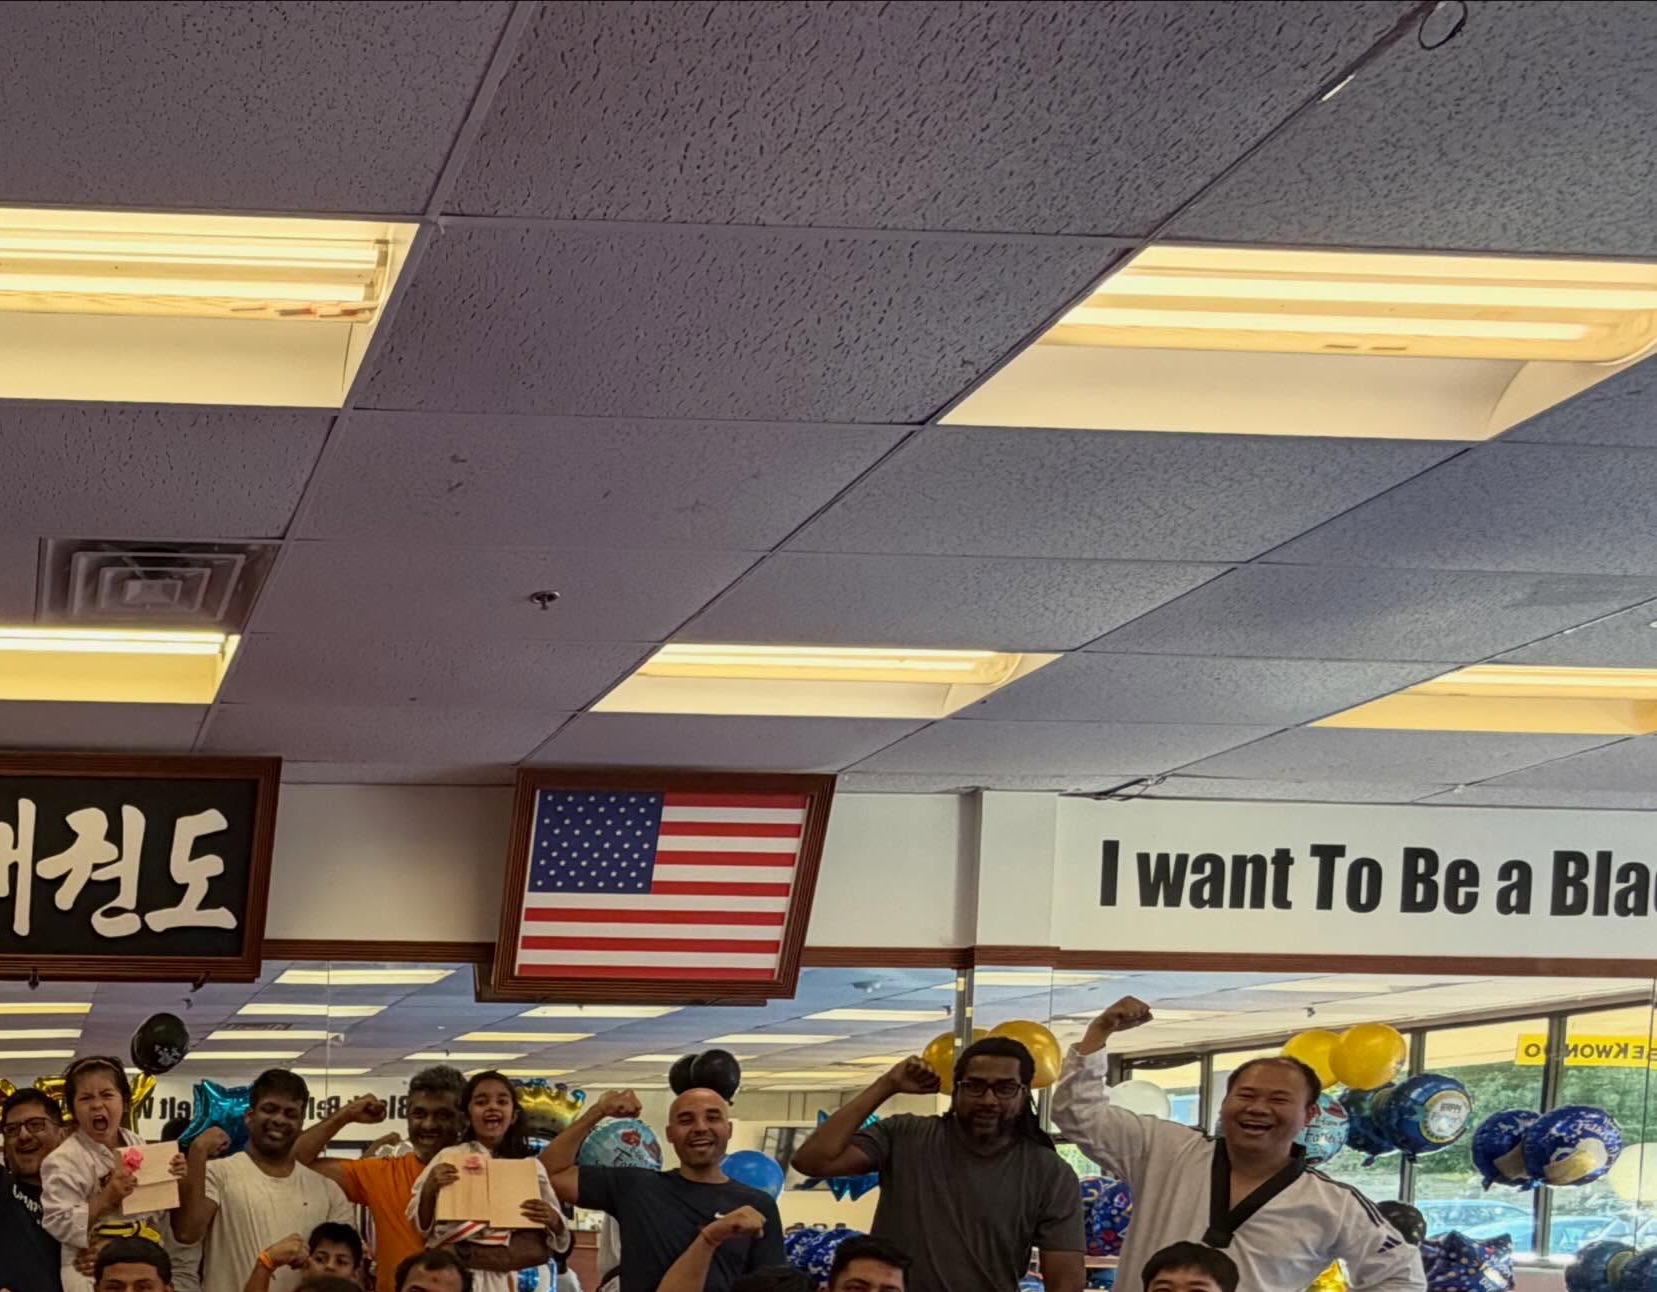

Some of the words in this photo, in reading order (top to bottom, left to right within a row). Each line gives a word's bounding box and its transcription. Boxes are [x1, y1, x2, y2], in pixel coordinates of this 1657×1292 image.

[1100, 839, 1120, 907] I
[1136, 847, 1294, 910] want
[1310, 843, 1383, 914] To
[1400, 846, 1480, 915] Be
[1496, 859, 1533, 915] a
[1550, 850, 1657, 917] Bla
